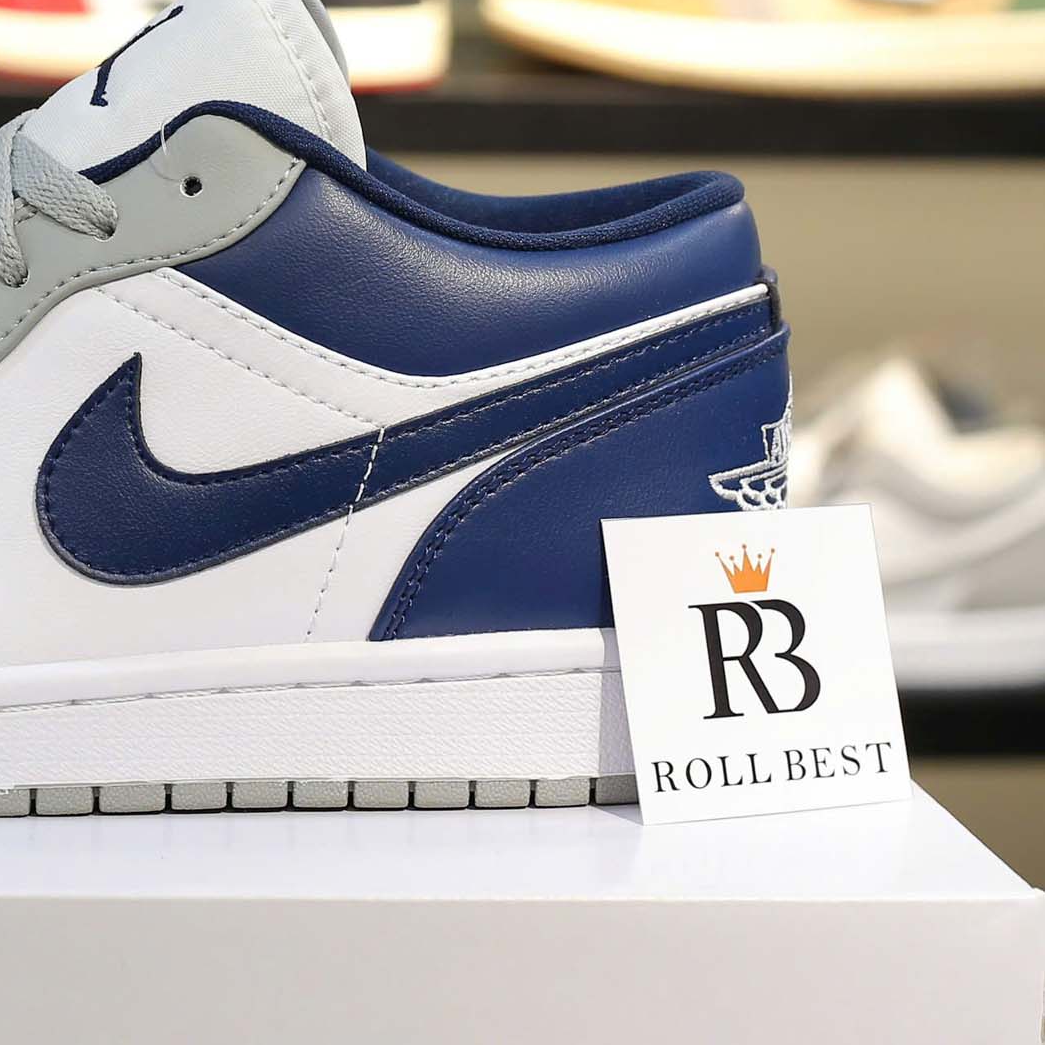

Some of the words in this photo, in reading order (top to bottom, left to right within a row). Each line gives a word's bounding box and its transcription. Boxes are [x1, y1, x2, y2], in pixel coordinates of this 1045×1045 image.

[688, 598, 821, 720] RB
[651, 753, 772, 793] ROLL
[784, 742, 892, 782] BEST
